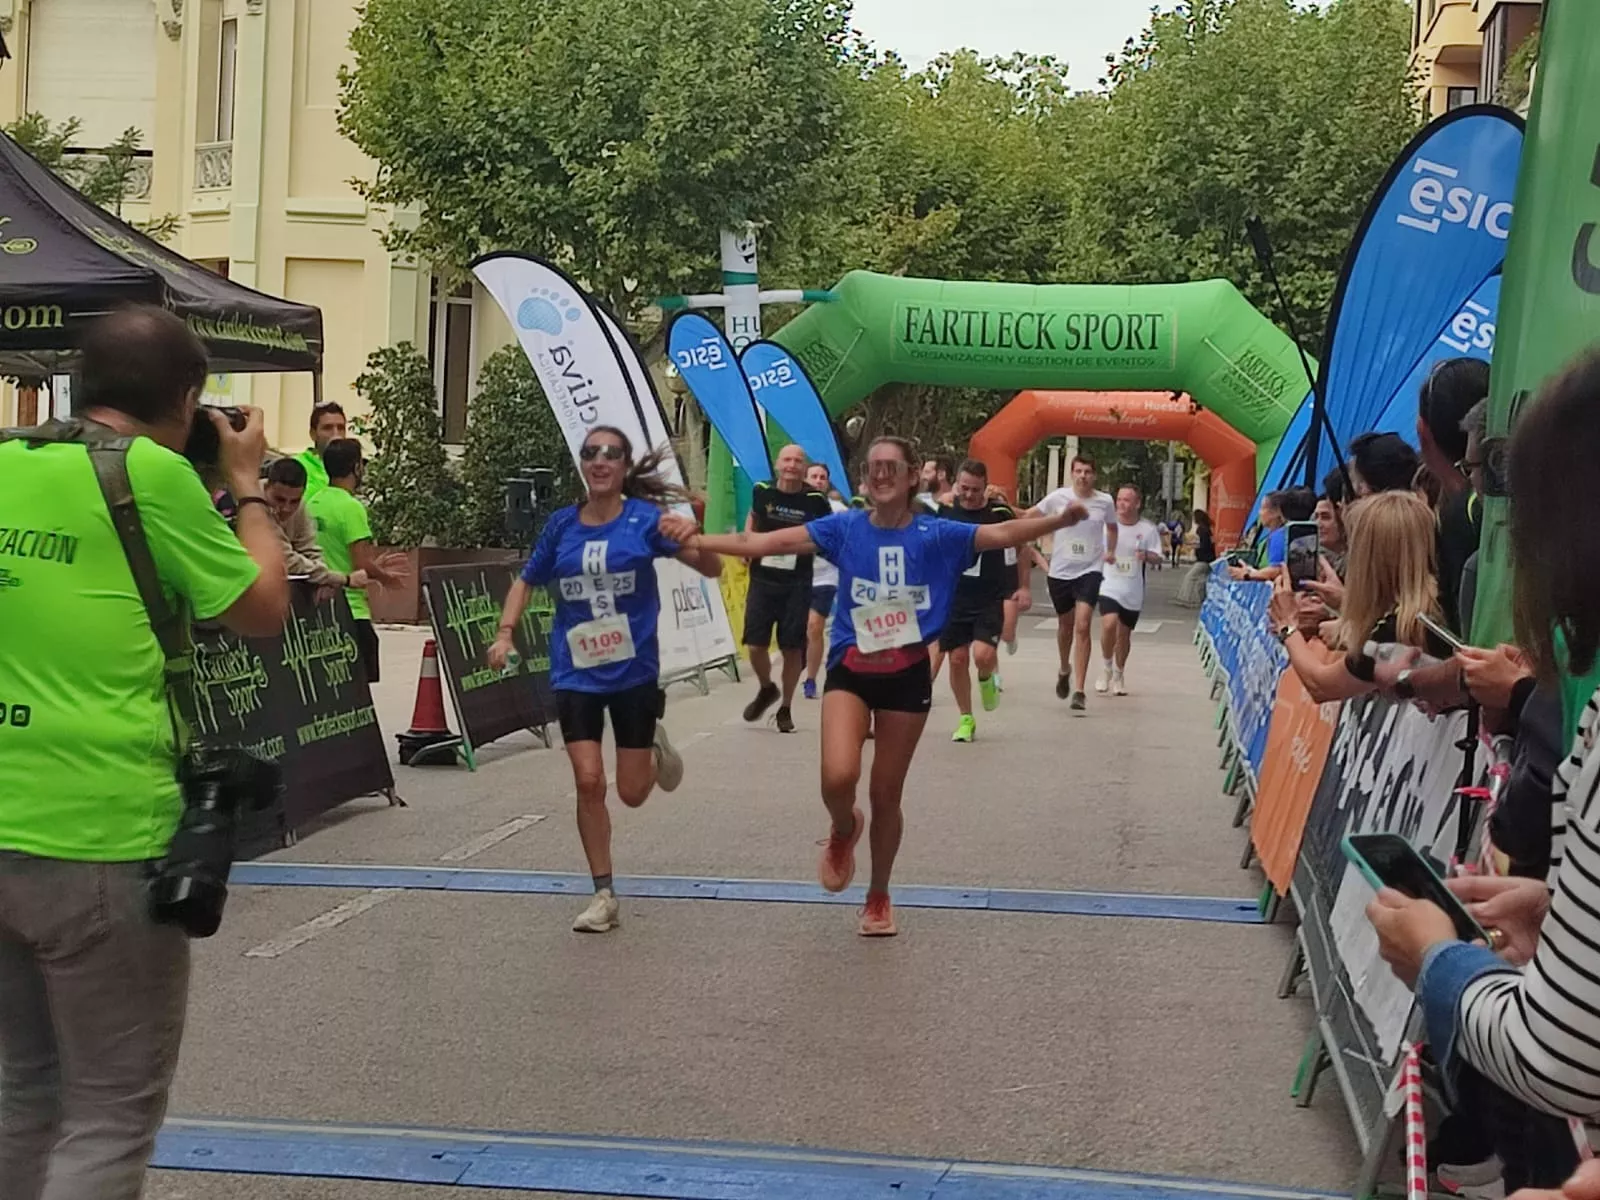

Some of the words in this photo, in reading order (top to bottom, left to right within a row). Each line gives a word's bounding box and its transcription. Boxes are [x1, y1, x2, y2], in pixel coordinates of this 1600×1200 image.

[903, 306, 1056, 351] FARTLECK
[1065, 313, 1164, 351] SPORT
[1007, 356, 1015, 365] Y
[1076, 357, 1092, 366] DE
[1096, 357, 1154, 366] EVENTOS
[563, 581, 583, 596] 20
[612, 576, 632, 591] 25
[856, 584, 876, 601] 20
[864, 611, 907, 633] 1100
[577, 631, 623, 651] 1109
